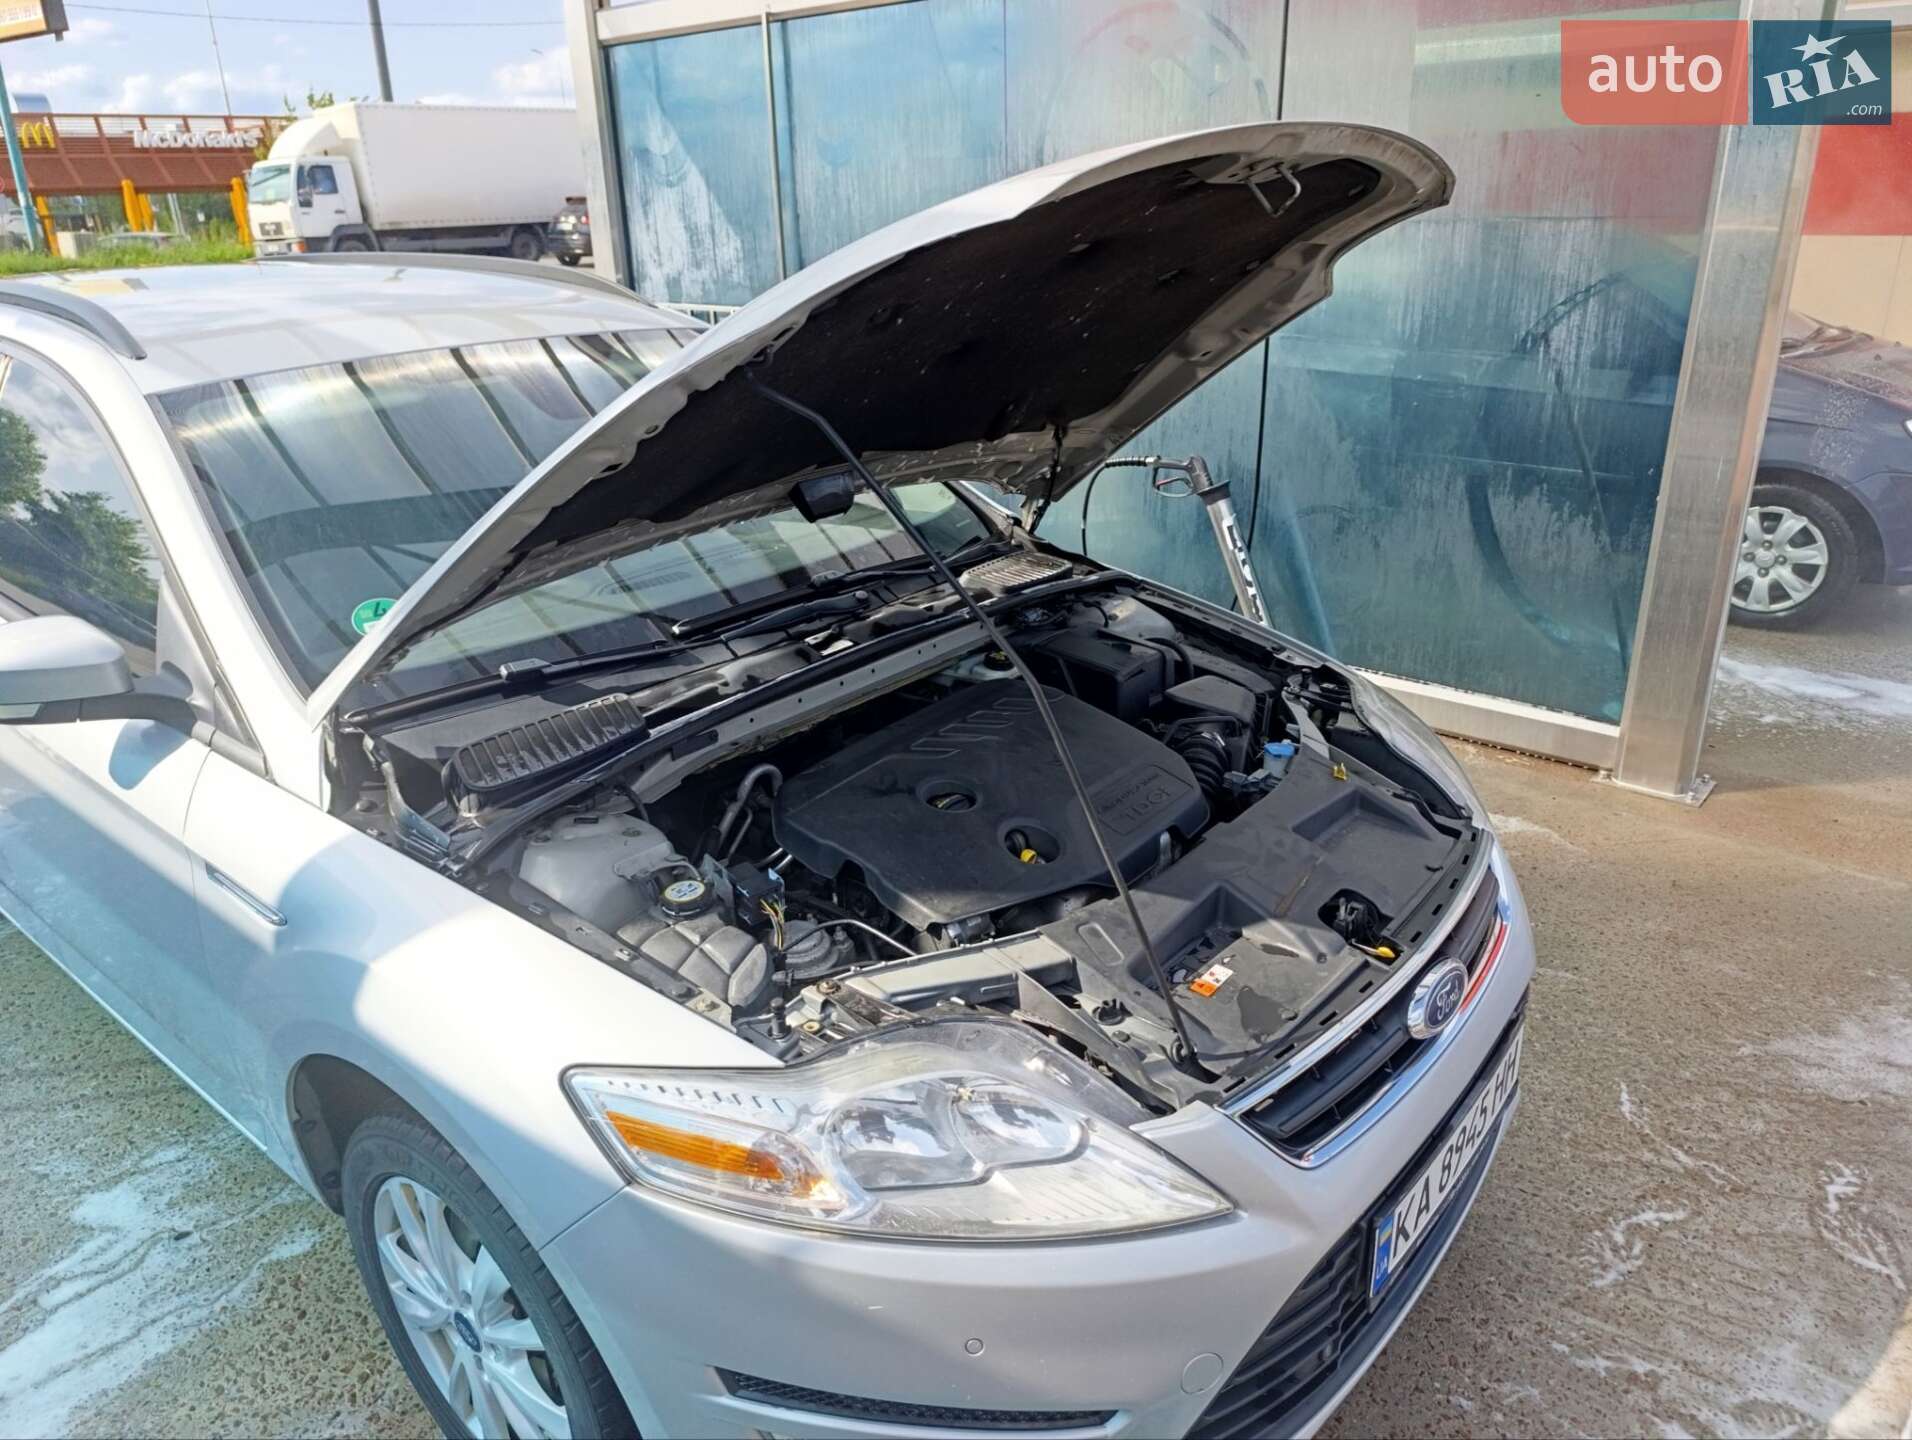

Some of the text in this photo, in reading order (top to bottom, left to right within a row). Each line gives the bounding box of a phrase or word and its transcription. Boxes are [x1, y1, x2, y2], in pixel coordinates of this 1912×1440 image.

[133, 129, 259, 148] McDonald's
[1436, 979, 1460, 1021] Ford
[1393, 1039, 1519, 1259] KA 8945 HH
